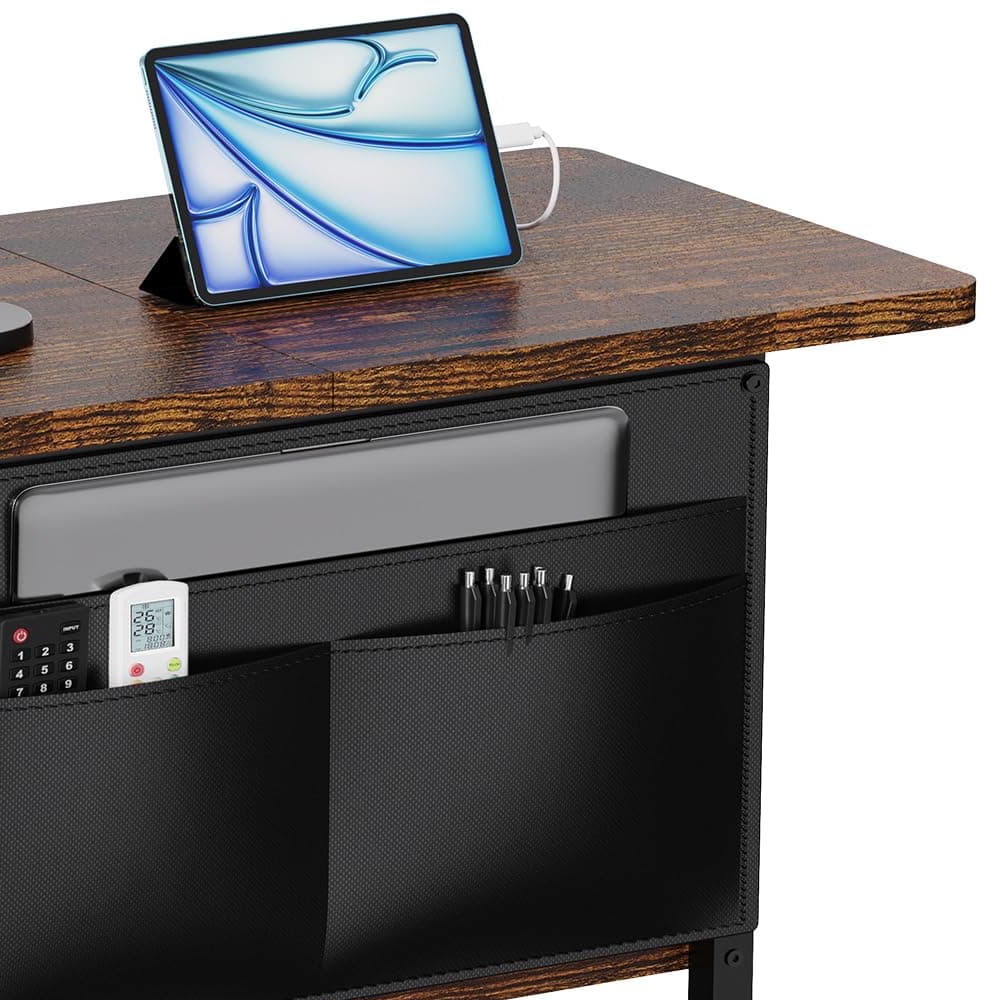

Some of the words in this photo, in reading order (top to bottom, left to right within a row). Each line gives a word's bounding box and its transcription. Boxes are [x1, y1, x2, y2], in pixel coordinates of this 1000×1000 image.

[133, 609, 155, 624] 26
[133, 623, 156, 637] 28
[17, 650, 24, 661] 1
[41, 646, 50, 657] 2
[66, 642, 74, 652] 3
[15, 669, 24, 679] 4
[41, 665, 49, 675] 5
[65, 660, 73, 671] 6
[16, 687, 24, 697] 7
[40, 683, 48, 693] 8
[64, 679, 72, 689] 9
